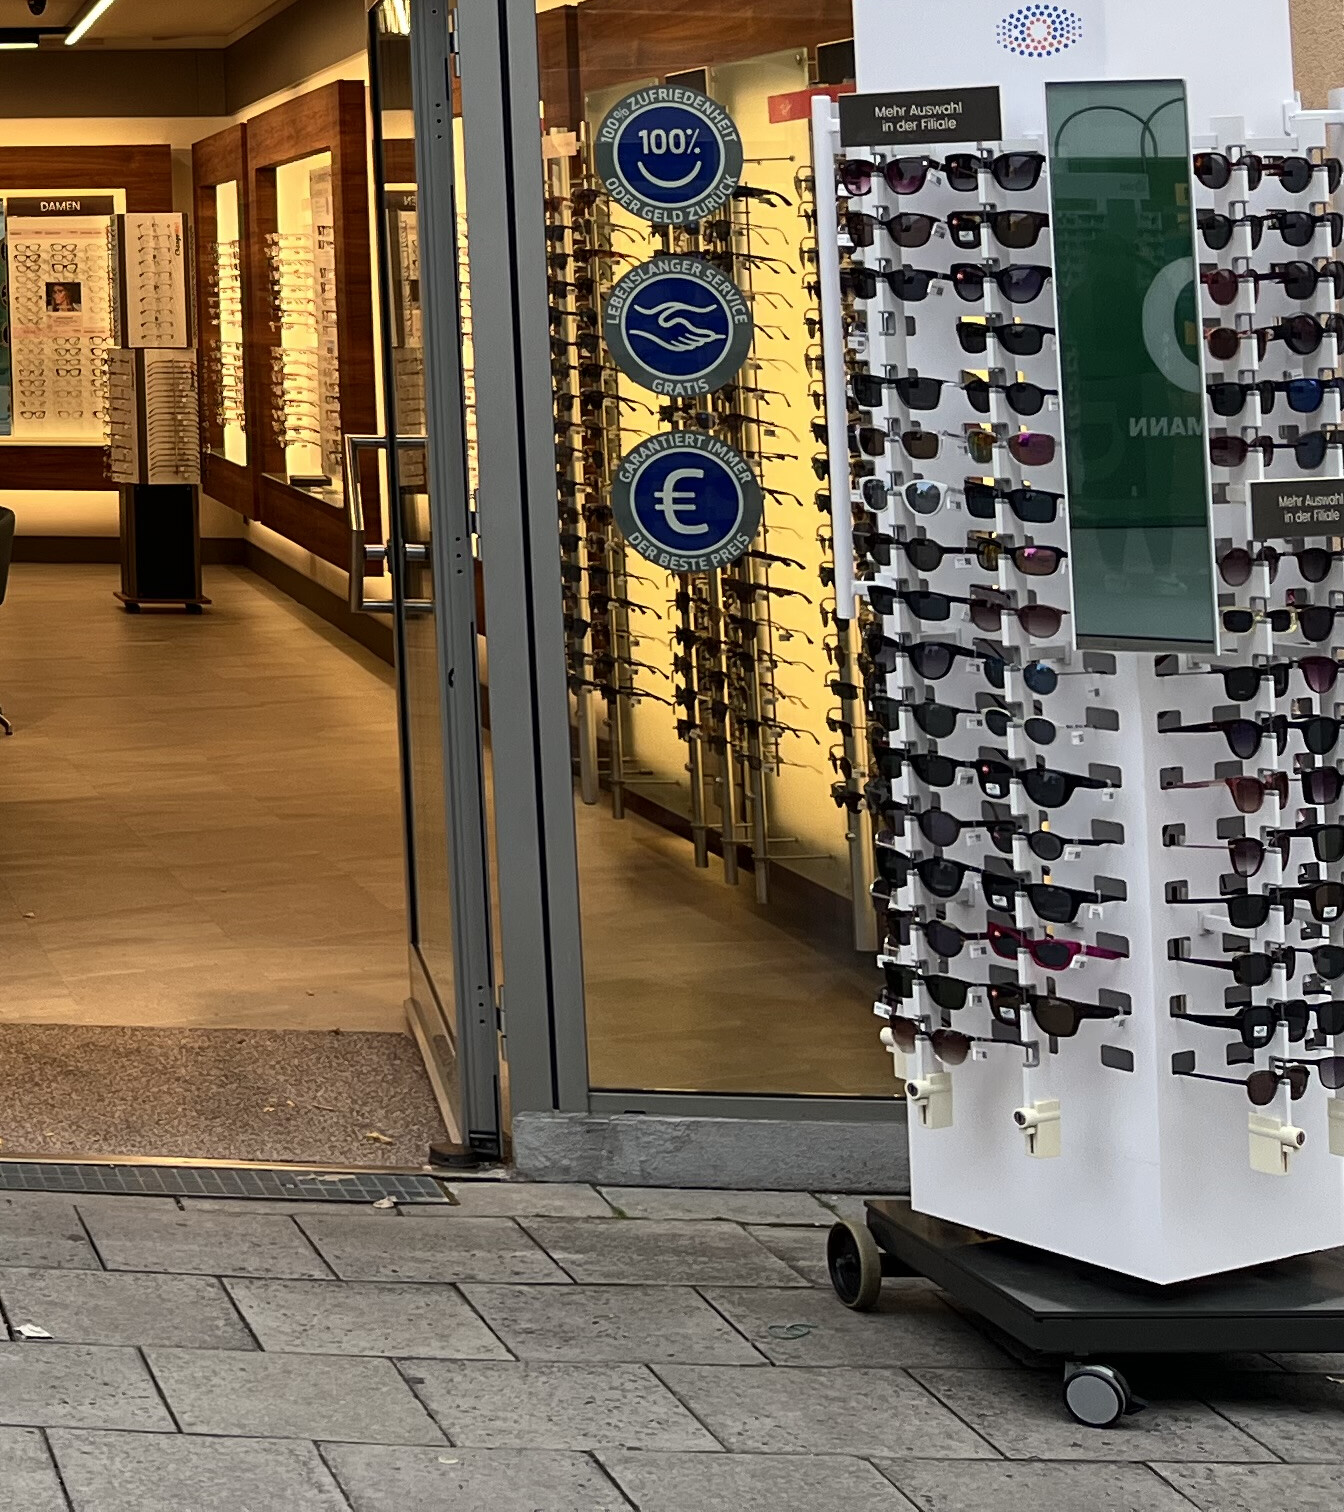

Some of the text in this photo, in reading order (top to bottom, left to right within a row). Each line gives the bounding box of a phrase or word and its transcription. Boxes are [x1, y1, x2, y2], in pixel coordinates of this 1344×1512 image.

[600, 88, 738, 144] 100% ZUFRIEDENHEIT
[874, 102, 962, 118] Mehr Auswahl
[882, 118, 957, 132] in der Filiale
[638, 128, 701, 155] 100%
[40, 201, 81, 212] DAMEN
[605, 174, 738, 223] ODER GELD ZURÜCK
[606, 259, 748, 324] LEBENSLANGER SERVICE
[652, 378, 710, 396] GRATIS
[619, 433, 753, 484] GARANTIERT IMMER
[653, 467, 709, 535] €
[1278, 492, 1344, 507] Mehr Auswahl
[1284, 508, 1340, 523] in der Filiale
[628, 531, 751, 571] DER BESTE PREIS
